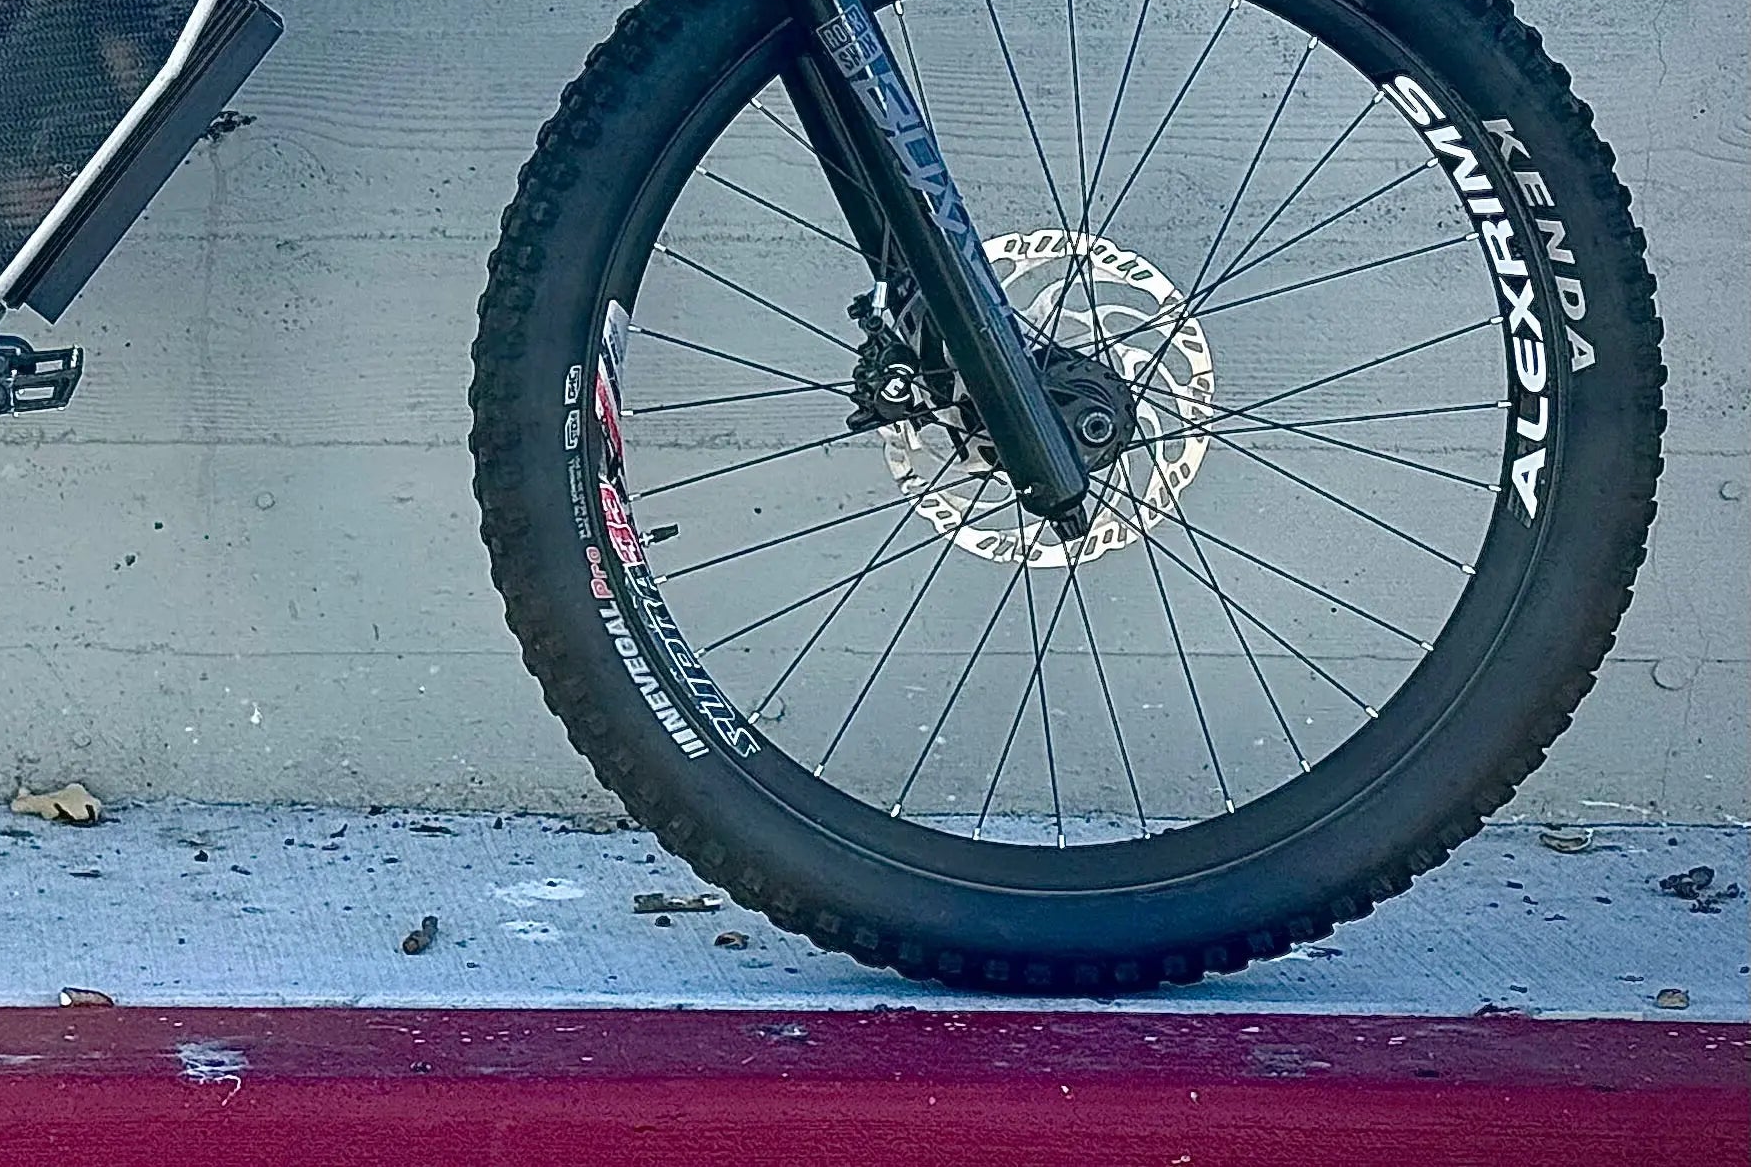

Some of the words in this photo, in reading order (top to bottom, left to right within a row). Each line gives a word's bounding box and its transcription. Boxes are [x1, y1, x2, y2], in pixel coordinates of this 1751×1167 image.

[823, 7, 866, 49] ROK
[1382, 73, 1550, 520] ALEXRIMS
[1482, 117, 1597, 372] KENDA
[600, 599, 689, 734] NEVEGAL
